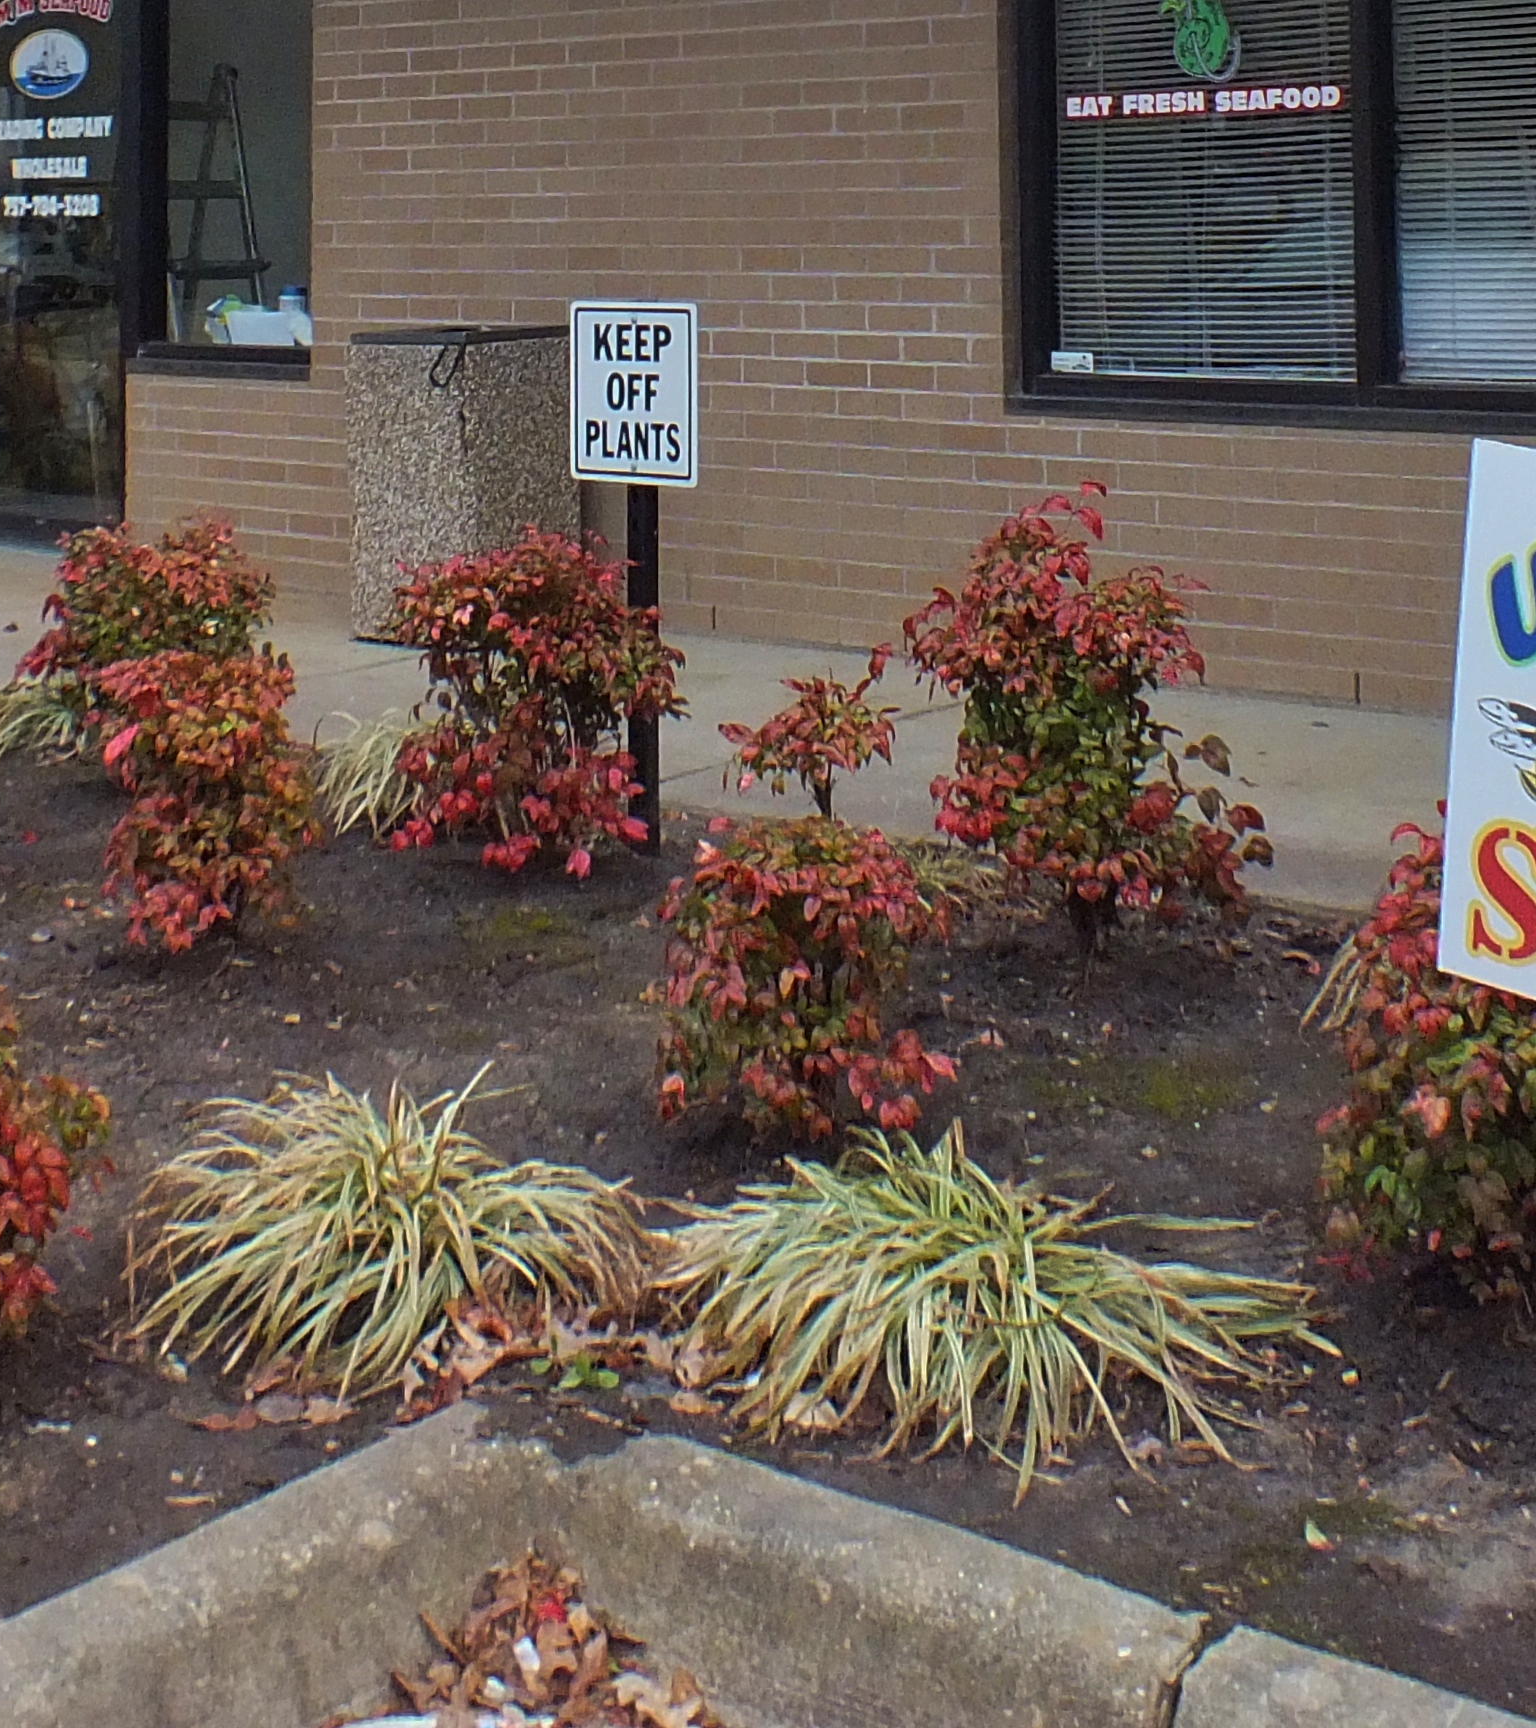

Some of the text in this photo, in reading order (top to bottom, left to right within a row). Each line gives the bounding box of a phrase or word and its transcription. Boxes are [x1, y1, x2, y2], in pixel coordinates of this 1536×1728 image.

[1066, 84, 1342, 118] EAT FRESH SEAFOOD
[47, 115, 113, 139] COMPANY
[11, 155, 87, 180] WHOLESALE
[593, 322, 673, 363] KEEP
[606, 371, 660, 412] OFF
[585, 419, 682, 463] PLANTS
